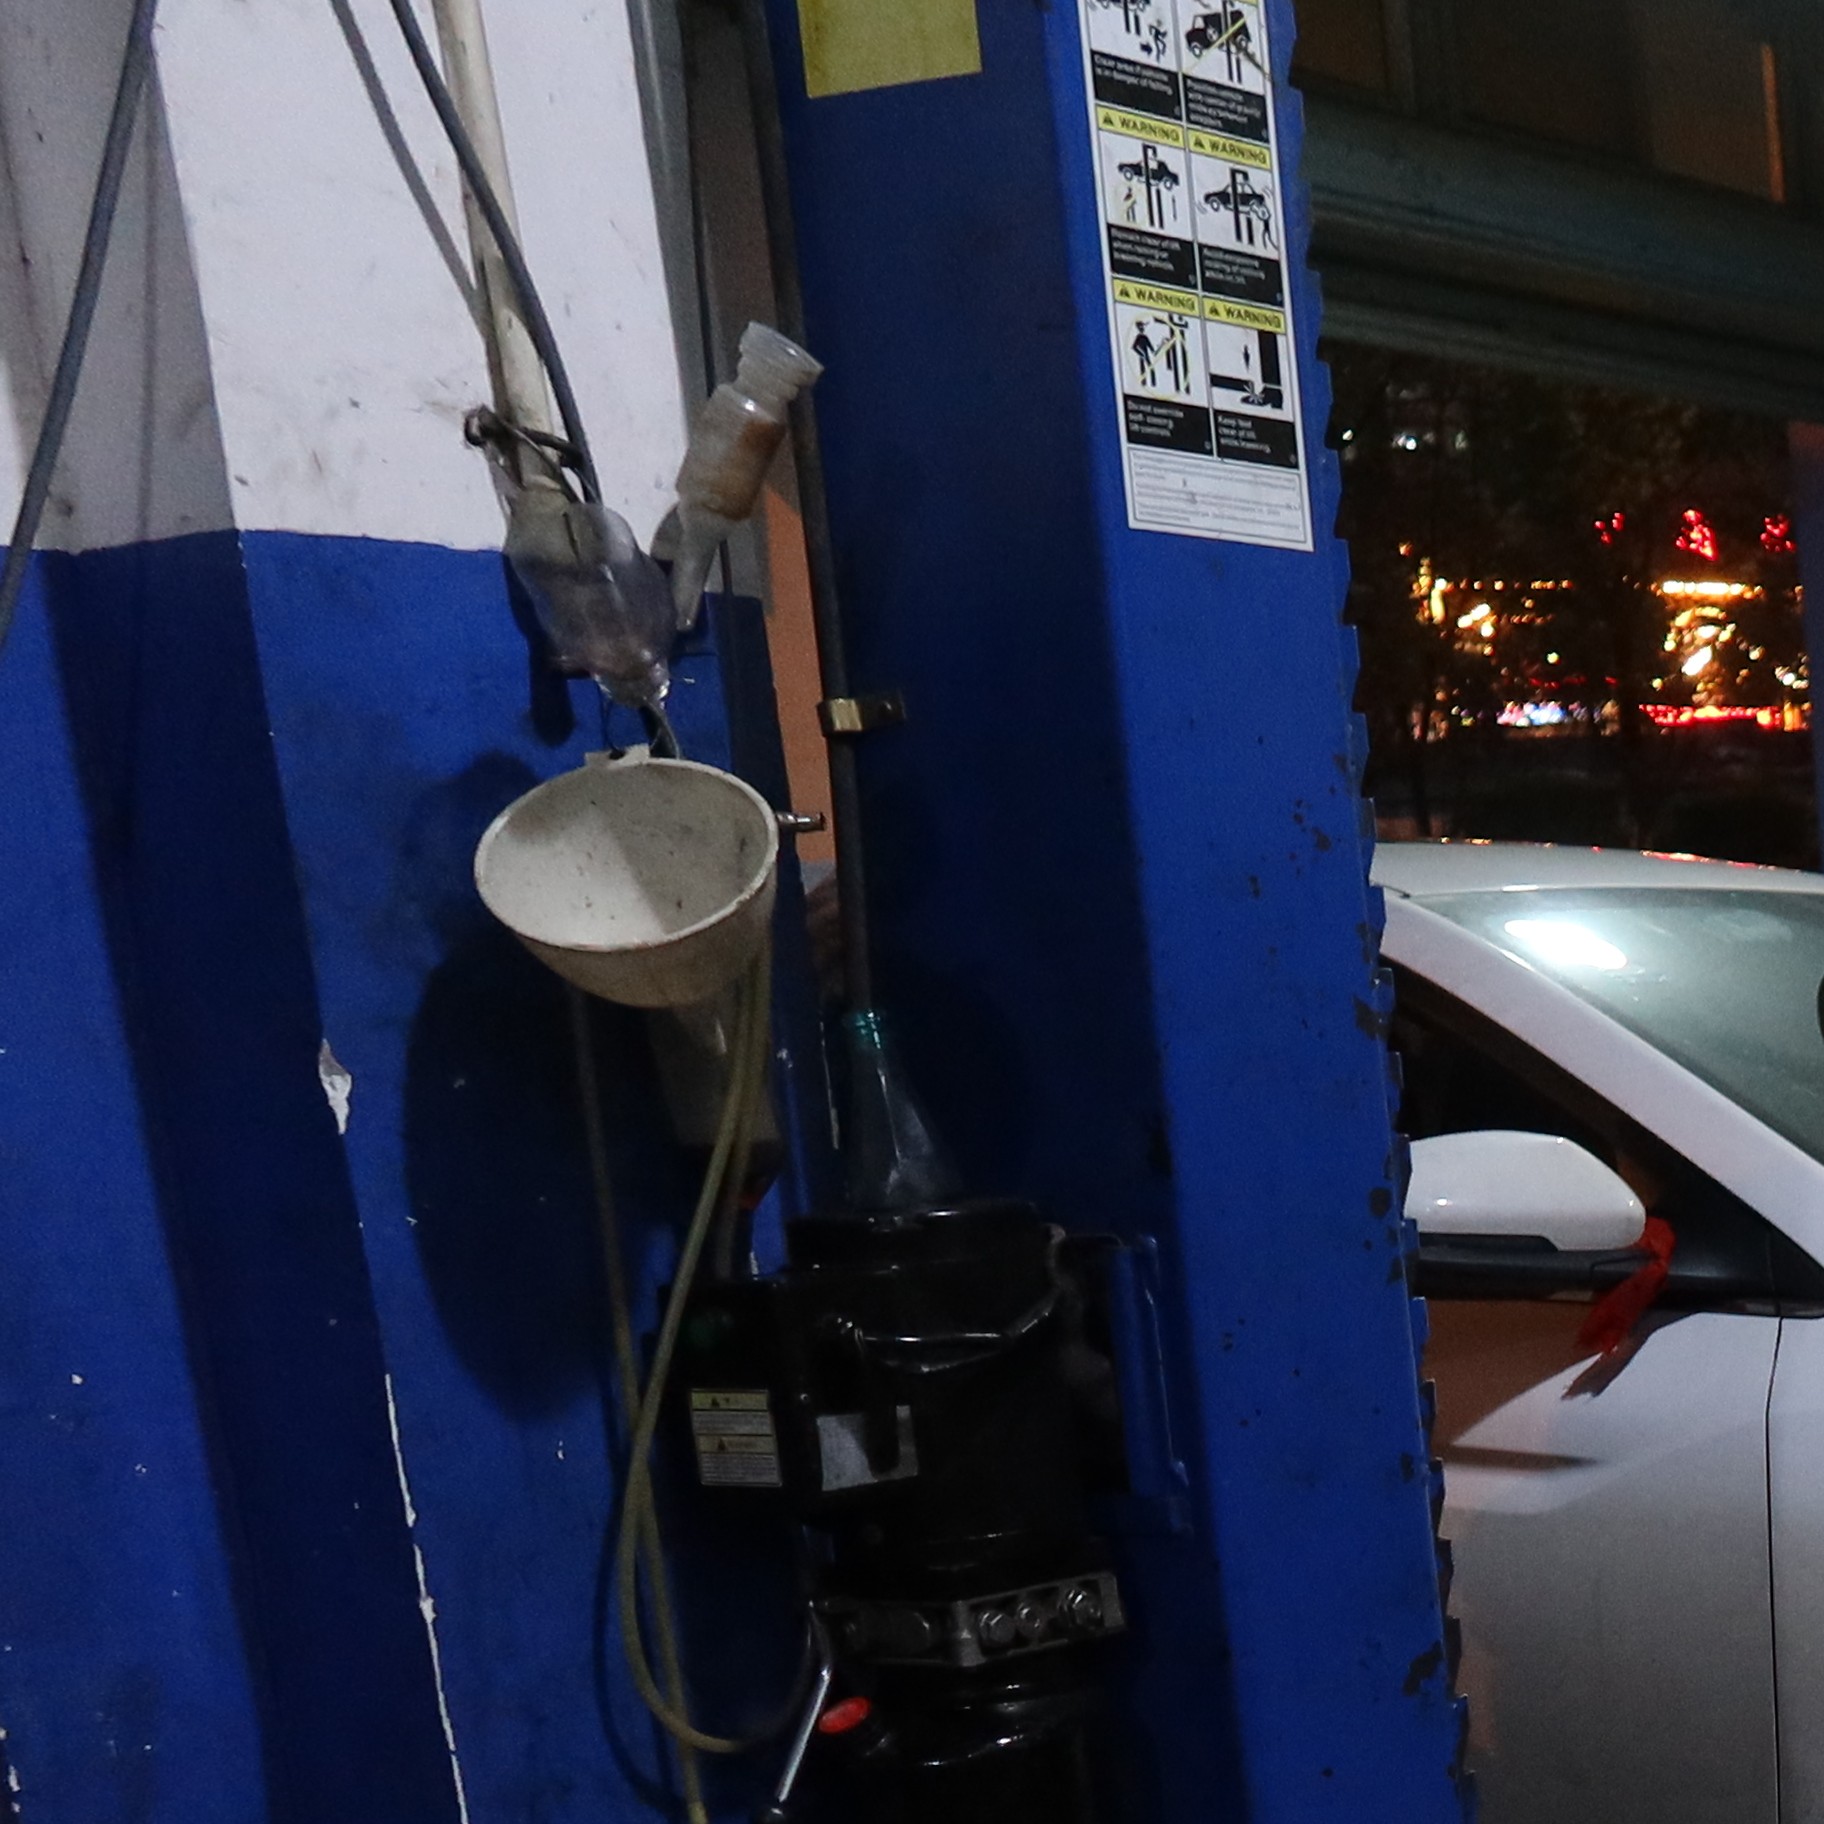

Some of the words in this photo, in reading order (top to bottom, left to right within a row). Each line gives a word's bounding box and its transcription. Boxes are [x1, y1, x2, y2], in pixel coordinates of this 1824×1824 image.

[1118, 115, 1180, 142] WARNING
[1208, 138, 1267, 165] WARNING
[1134, 287, 1196, 312] WARNING
[1223, 307, 1282, 329] WARNING
